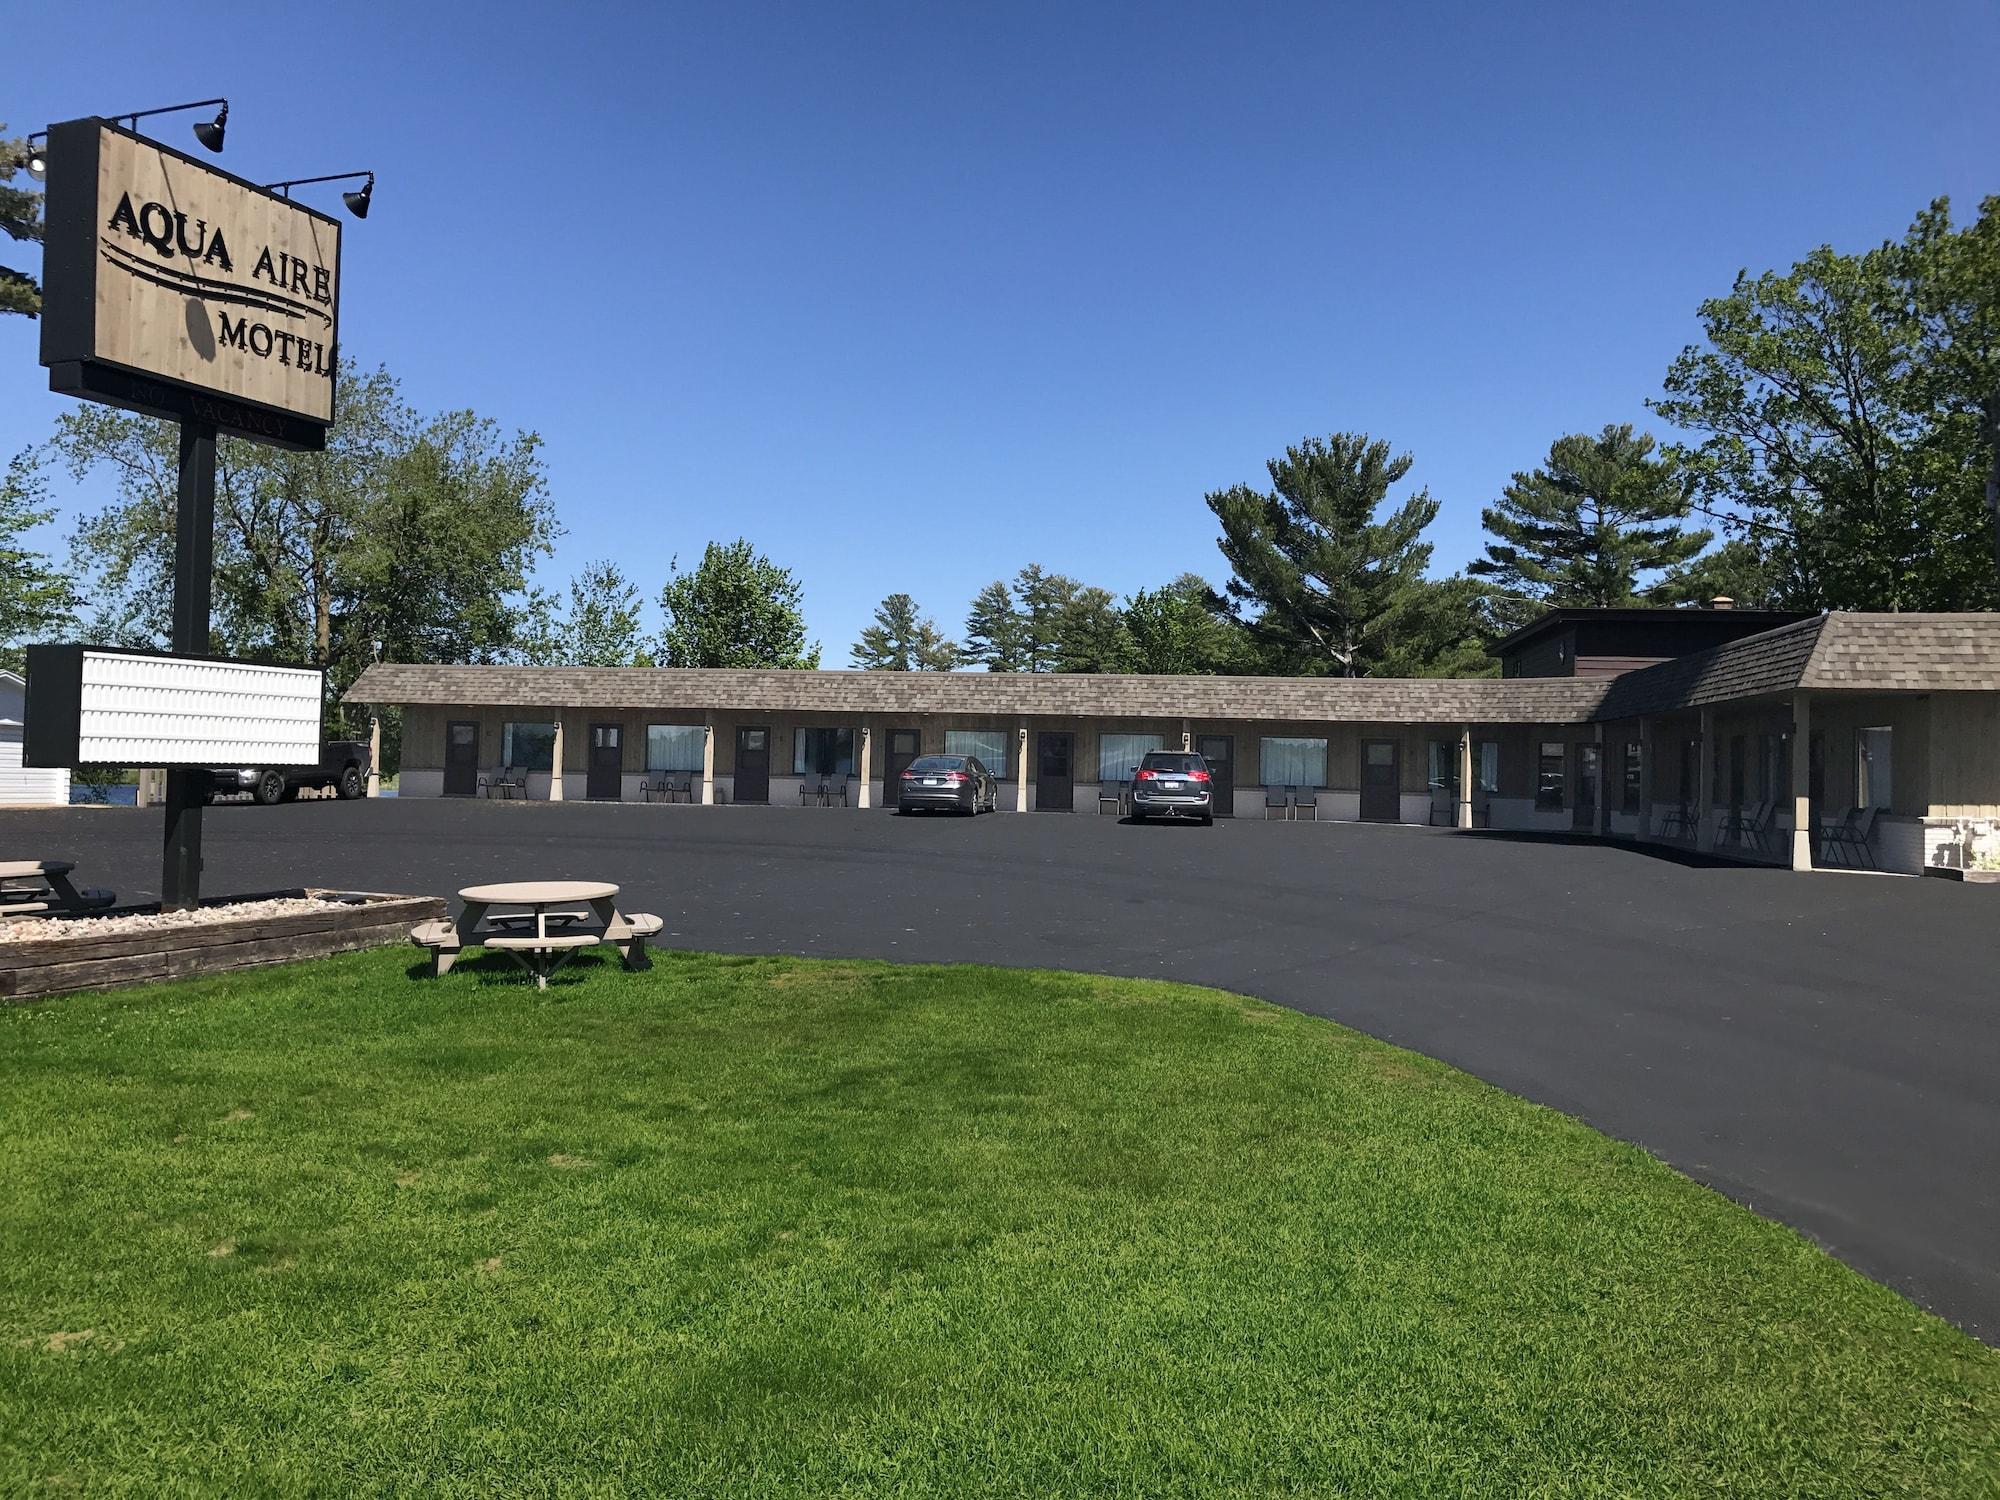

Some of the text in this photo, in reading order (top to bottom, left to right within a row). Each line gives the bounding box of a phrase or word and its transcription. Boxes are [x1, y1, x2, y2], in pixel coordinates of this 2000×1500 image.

[108, 191, 331, 306] AQUA AIRE
[217, 310, 332, 378] MOTEL
[190, 396, 289, 437] VACANCY
